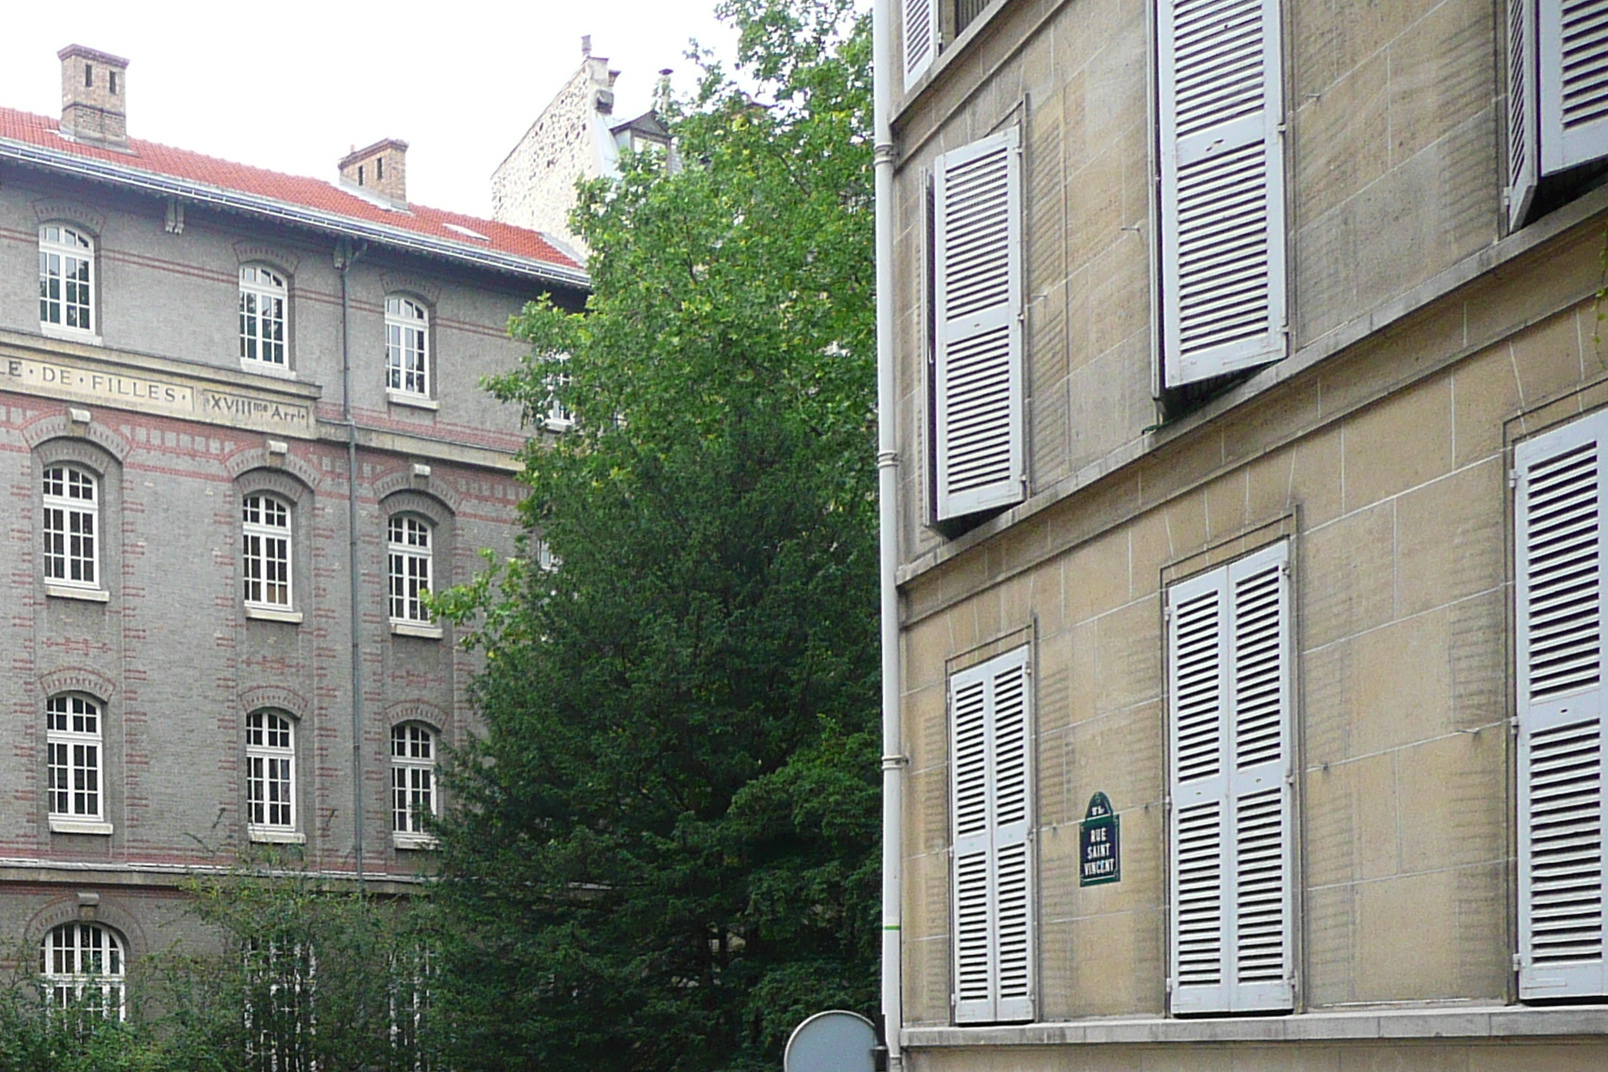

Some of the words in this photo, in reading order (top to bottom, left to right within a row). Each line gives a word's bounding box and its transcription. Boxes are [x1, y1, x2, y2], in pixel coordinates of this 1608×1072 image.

[42, 366, 73, 386] DE
[92, 375, 175, 402] FILLES
[1090, 827, 1108, 842] RUE
[1087, 843, 1111, 860] SAINT
[1084, 858, 1114, 876] VINCENT
